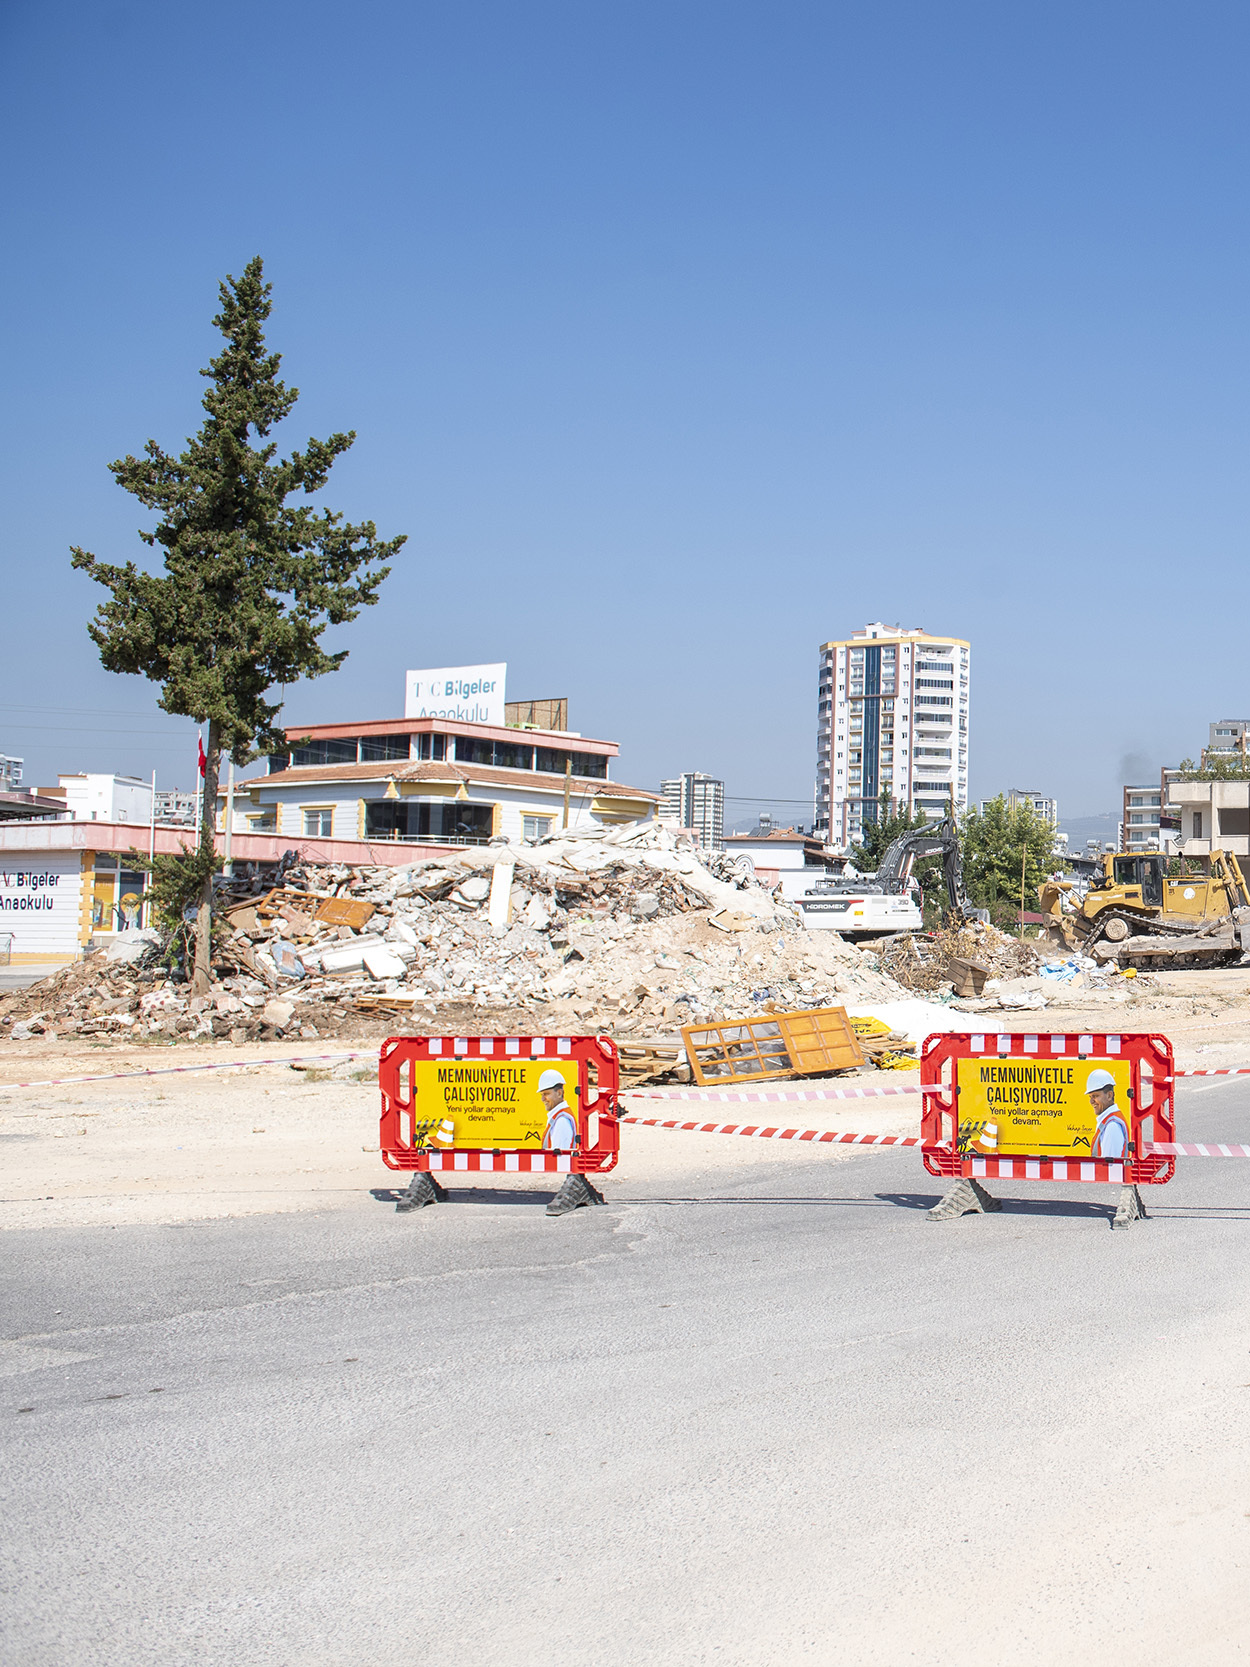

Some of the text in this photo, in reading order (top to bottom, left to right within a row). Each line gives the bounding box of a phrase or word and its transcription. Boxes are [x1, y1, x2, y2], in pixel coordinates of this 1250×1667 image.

[445, 679, 497, 699] Bilgeler
[16, 871, 60, 891] Bilgeler
[0, 894, 53, 910] Anaokulu
[438, 1066, 527, 1083] MEMNUNİYETLE
[980, 1064, 1074, 1084] MEMNUNİYETLE
[444, 1087, 520, 1104] ÇALIŞIYORUZ.
[987, 1087, 1067, 1106] ÇALIŞIYORUZ.
[447, 1105, 516, 1114] Yeni yollar açmaya
[468, 1114, 495, 1122] devam.
[989, 1107, 1063, 1118] Yeni yollar açmaya
[1012, 1117, 1042, 1126] devam.
